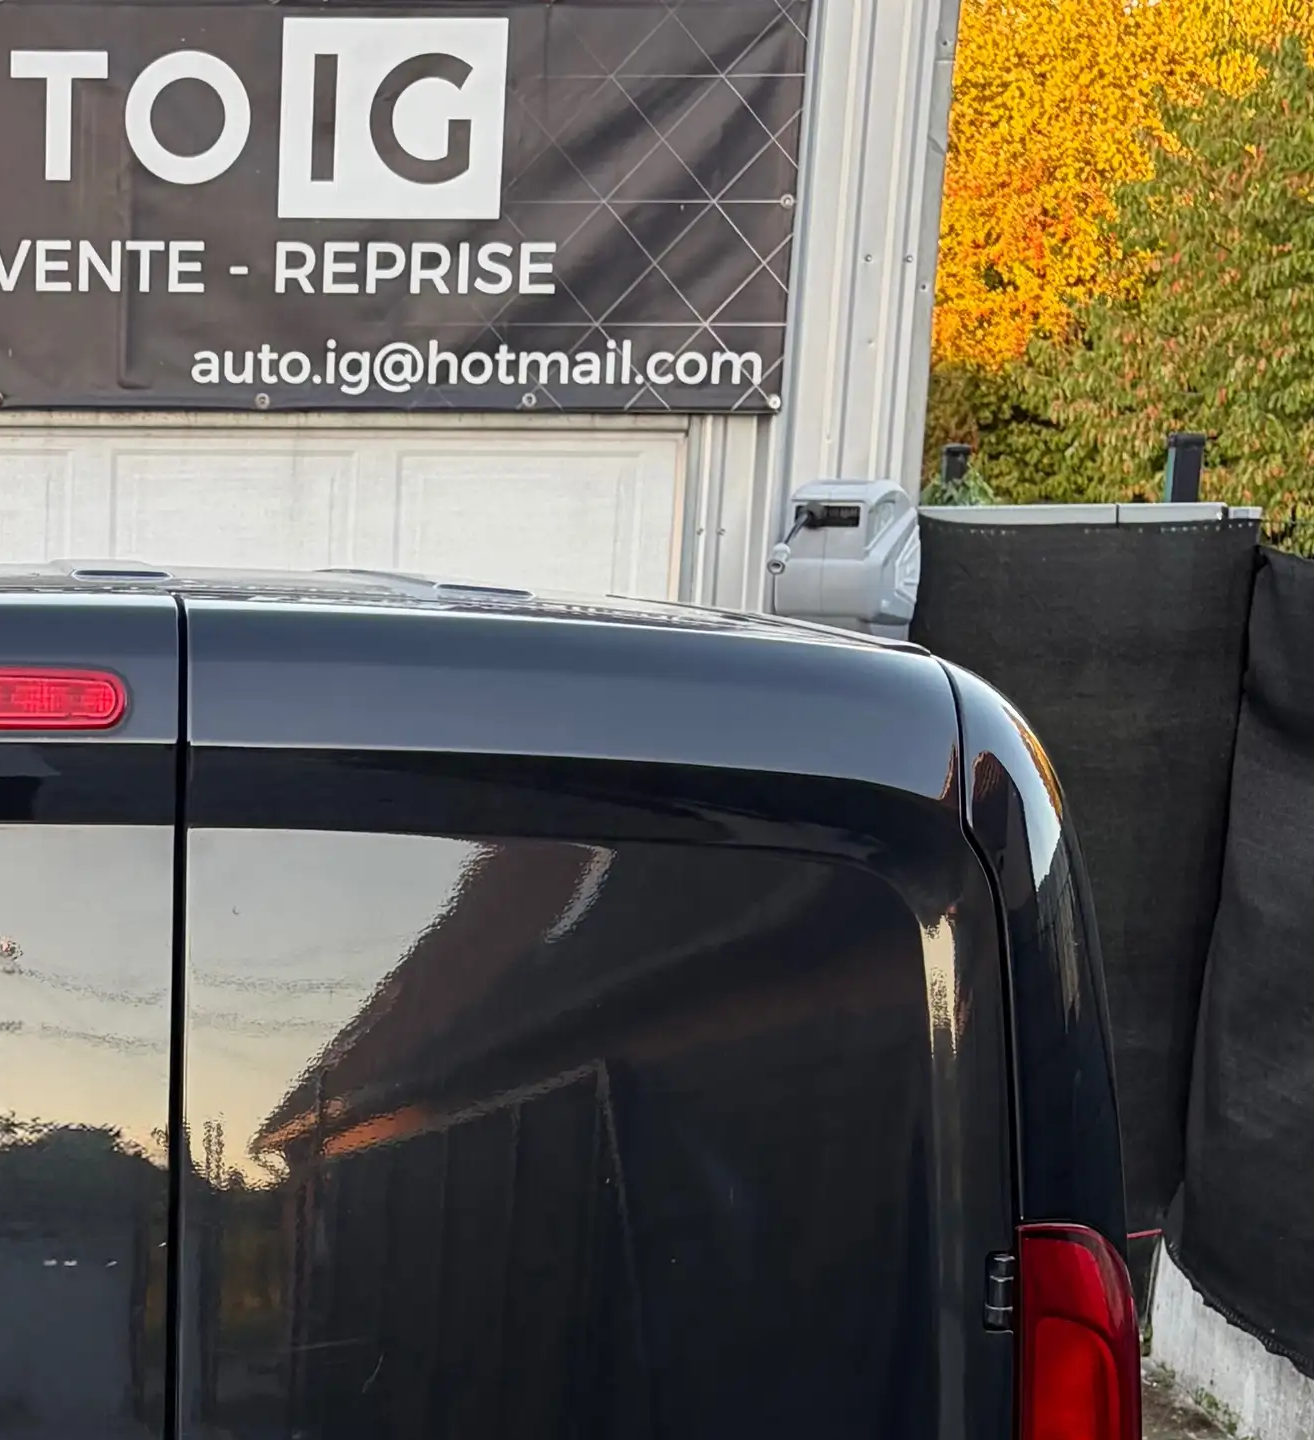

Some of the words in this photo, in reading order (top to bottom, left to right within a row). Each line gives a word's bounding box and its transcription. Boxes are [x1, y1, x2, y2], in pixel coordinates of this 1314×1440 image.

[308, 52, 475, 185] IG
[273, 242, 558, 295] REPRISE
[191, 339, 764, 394] auto.ig@hotmail.com
